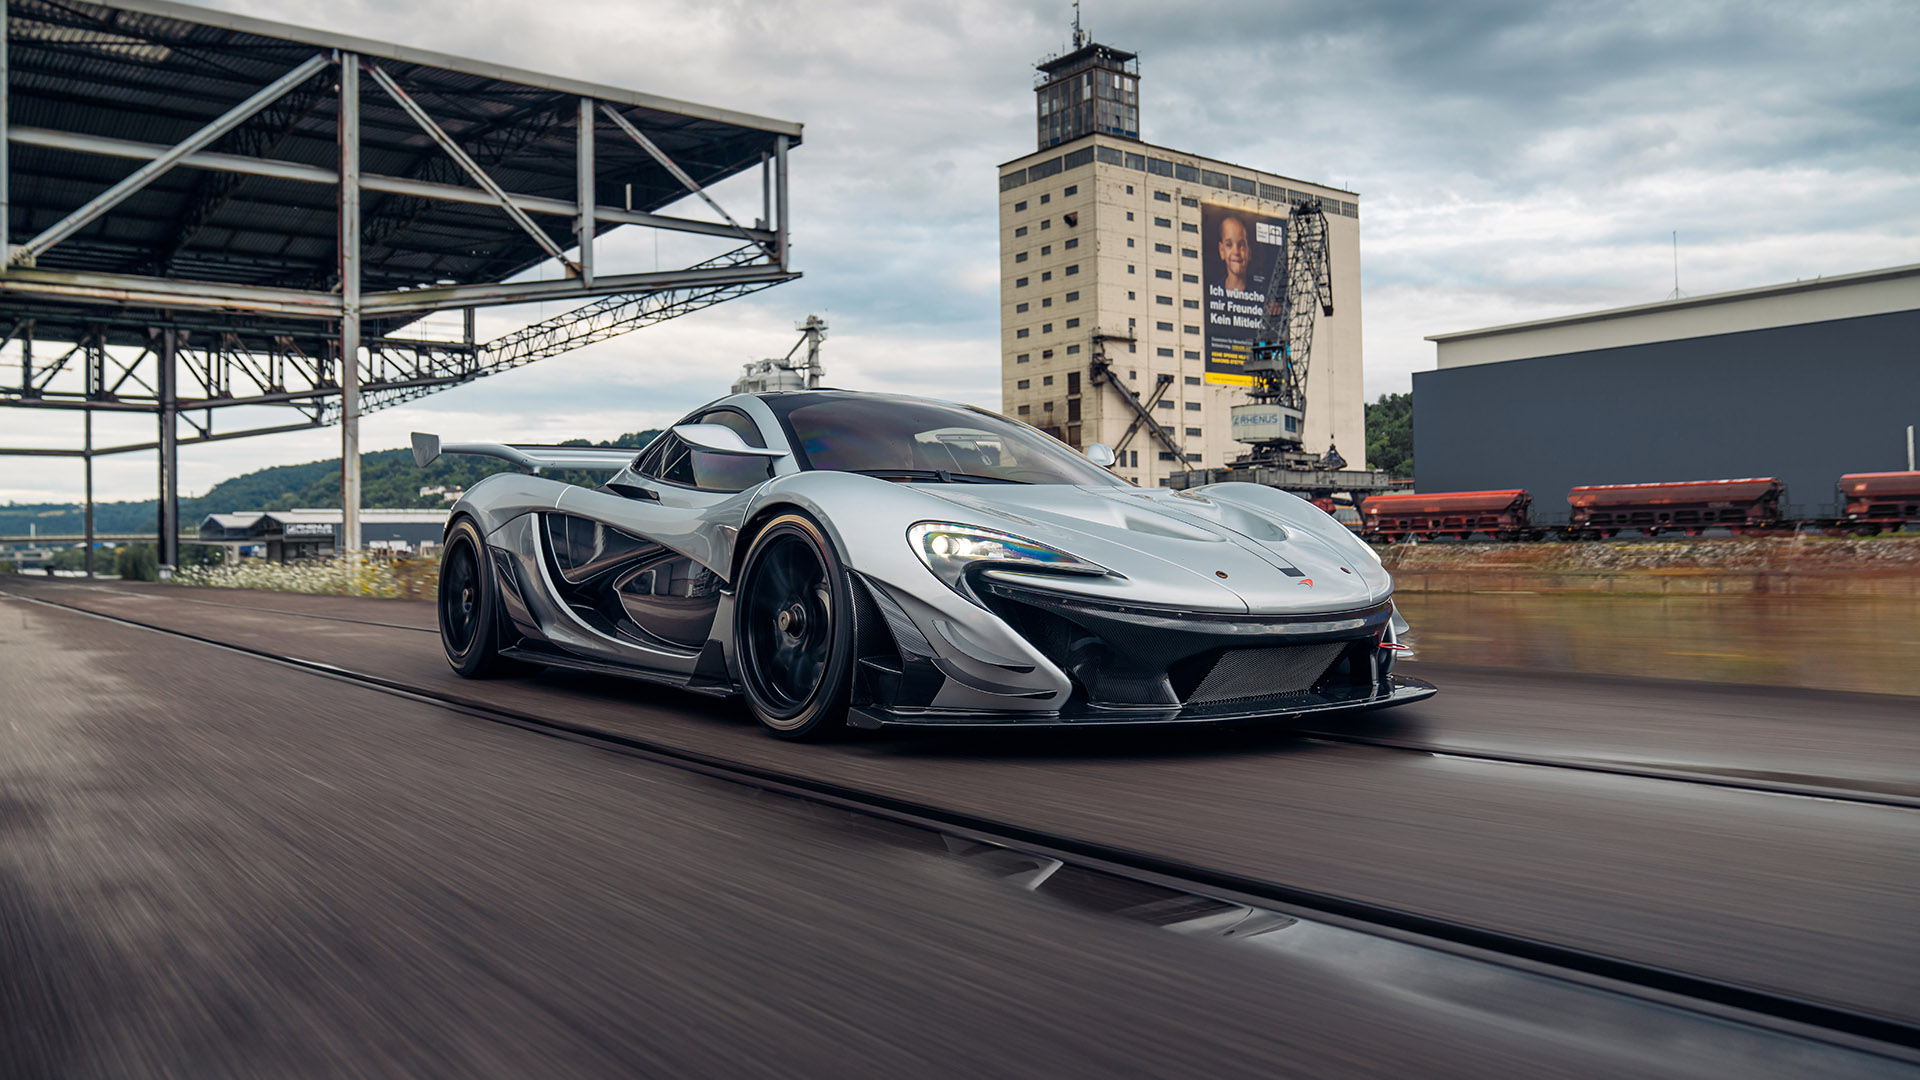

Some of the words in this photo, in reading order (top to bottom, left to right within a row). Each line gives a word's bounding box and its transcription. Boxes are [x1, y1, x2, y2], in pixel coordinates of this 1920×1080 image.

[1210, 284, 1224, 297] Ich
[1225, 287, 1265, 303] wünsche
[1210, 299, 1226, 311] mir
[1227, 301, 1263, 316] Freunde
[1210, 312, 1231, 325] Kein
[1240, 413, 1279, 425] RHENUS
